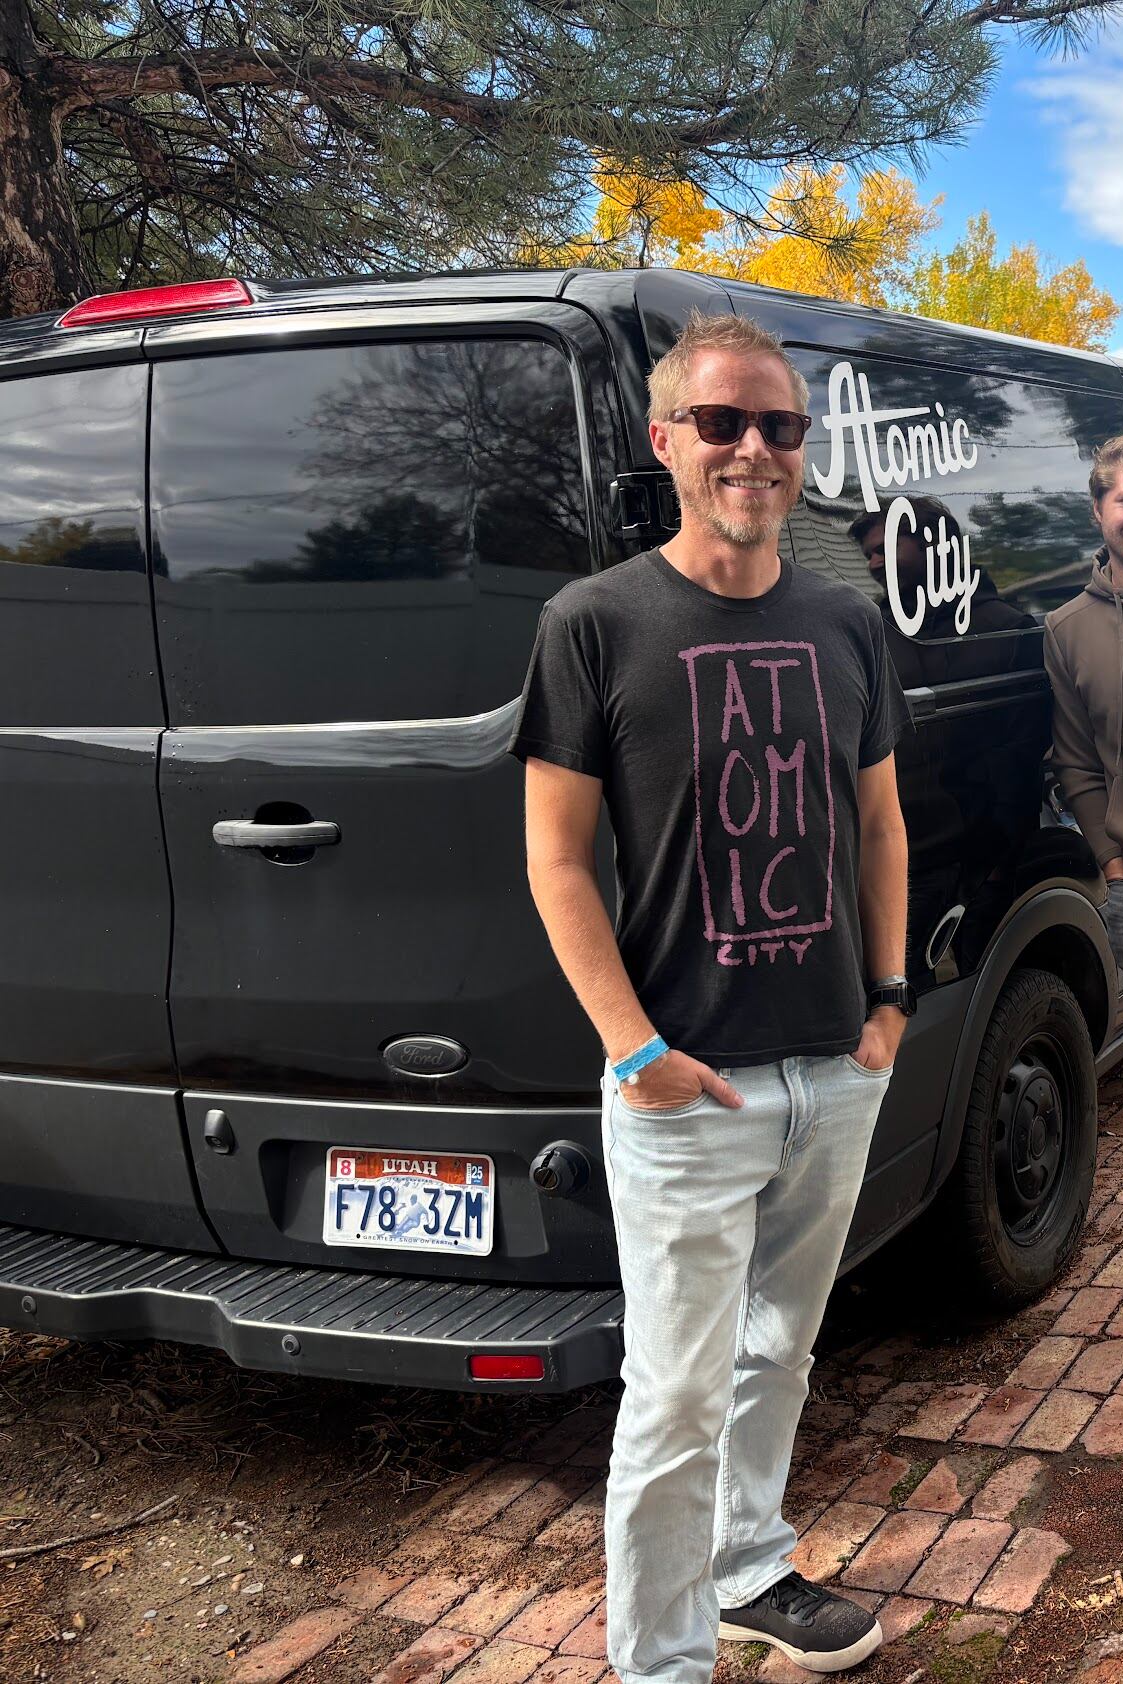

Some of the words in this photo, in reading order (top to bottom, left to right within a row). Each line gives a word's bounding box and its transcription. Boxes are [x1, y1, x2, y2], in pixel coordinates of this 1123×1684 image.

[812, 361, 978, 513] Atomic
[884, 496, 981, 637] City
[720, 658, 801, 743] AT
[718, 738, 806, 839] OM
[716, 938, 813, 966] CITY
[400, 1044, 445, 1066] Ford
[340, 1159, 352, 1176] 8
[381, 1158, 438, 1177] UTAH
[471, 1165, 483, 1180] 25
[335, 1183, 396, 1232] F78
[423, 1187, 483, 1240] 3ZM
